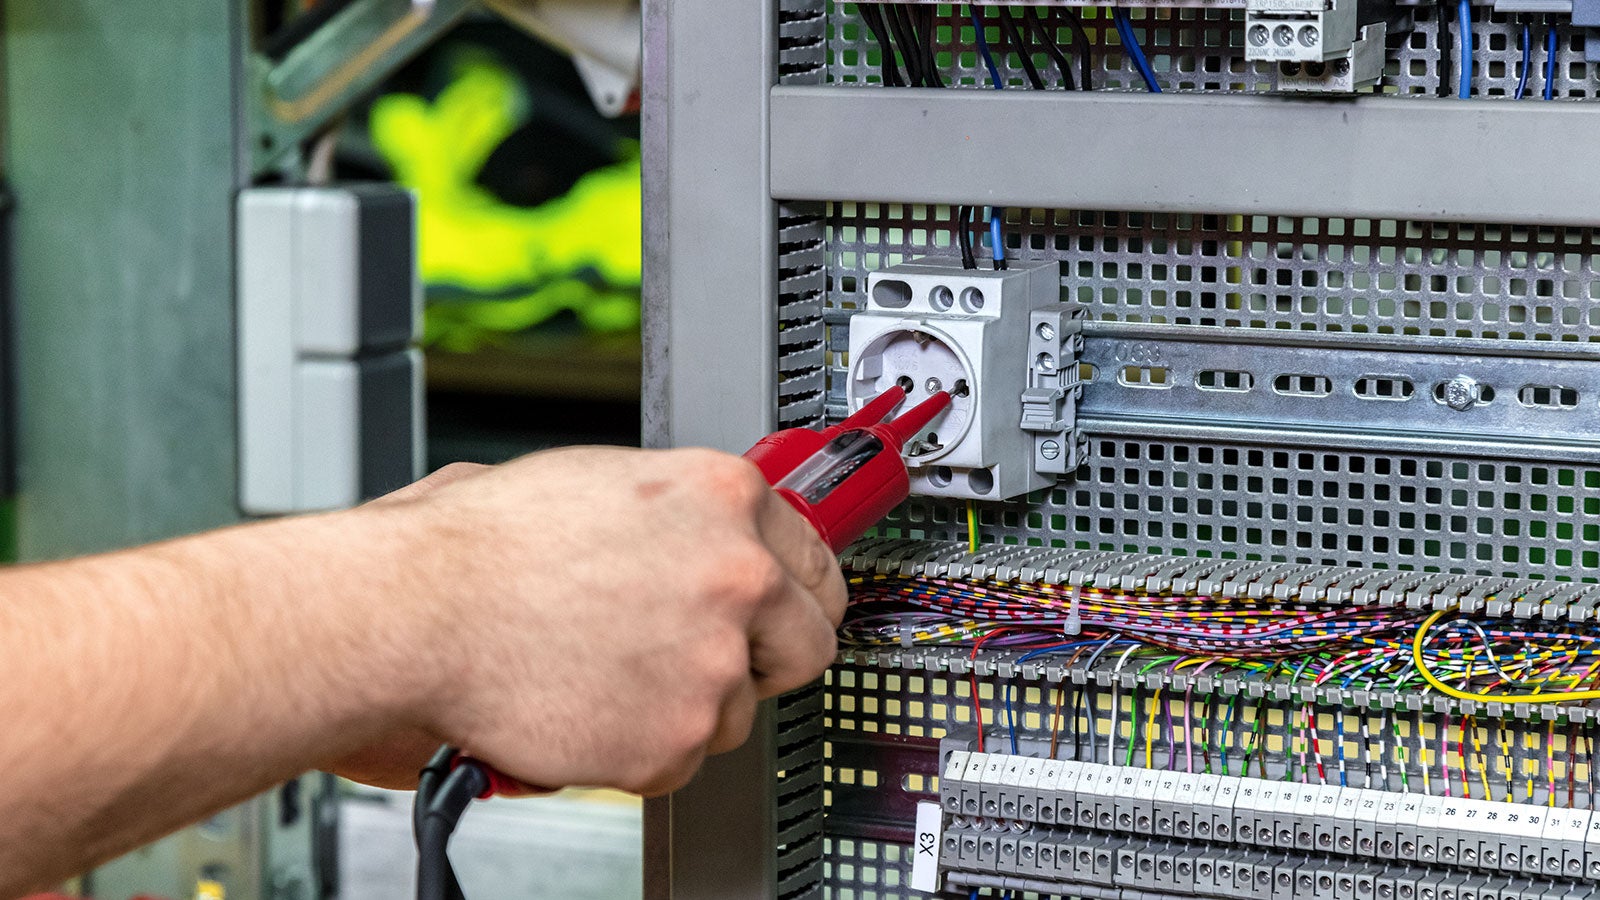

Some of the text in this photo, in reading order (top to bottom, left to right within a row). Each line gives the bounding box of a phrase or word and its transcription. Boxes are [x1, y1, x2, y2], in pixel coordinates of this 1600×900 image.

[1123, 777, 1133, 785] 10
[1144, 779, 1152, 788] 11
[1163, 781, 1173, 790] 12
[1182, 783, 1191, 792] 13
[1202, 784, 1211, 792] 14
[1222, 786, 1232, 795] 15
[1244, 788, 1253, 797] 16
[1263, 790, 1273, 799] 17
[1283, 792, 1293, 801] 18
[1303, 794, 1313, 803] 19
[1322, 795, 1334, 805] 20
[1343, 798, 1353, 807] 21
[1363, 799, 1375, 809] 22
[1383, 802, 1395, 811] 23
[1404, 803, 1415, 812] 24
[1425, 806, 1437, 815] 25
[1445, 807, 1457, 816] 26
[1466, 809, 1478, 818] 27
[1486, 811, 1498, 821] 28
[1507, 813, 1519, 822] 29
[1528, 815, 1540, 825] 30
[1550, 818, 1561, 827] 31
[1570, 819, 1583, 829] 32
[918, 832, 936, 857] X3
